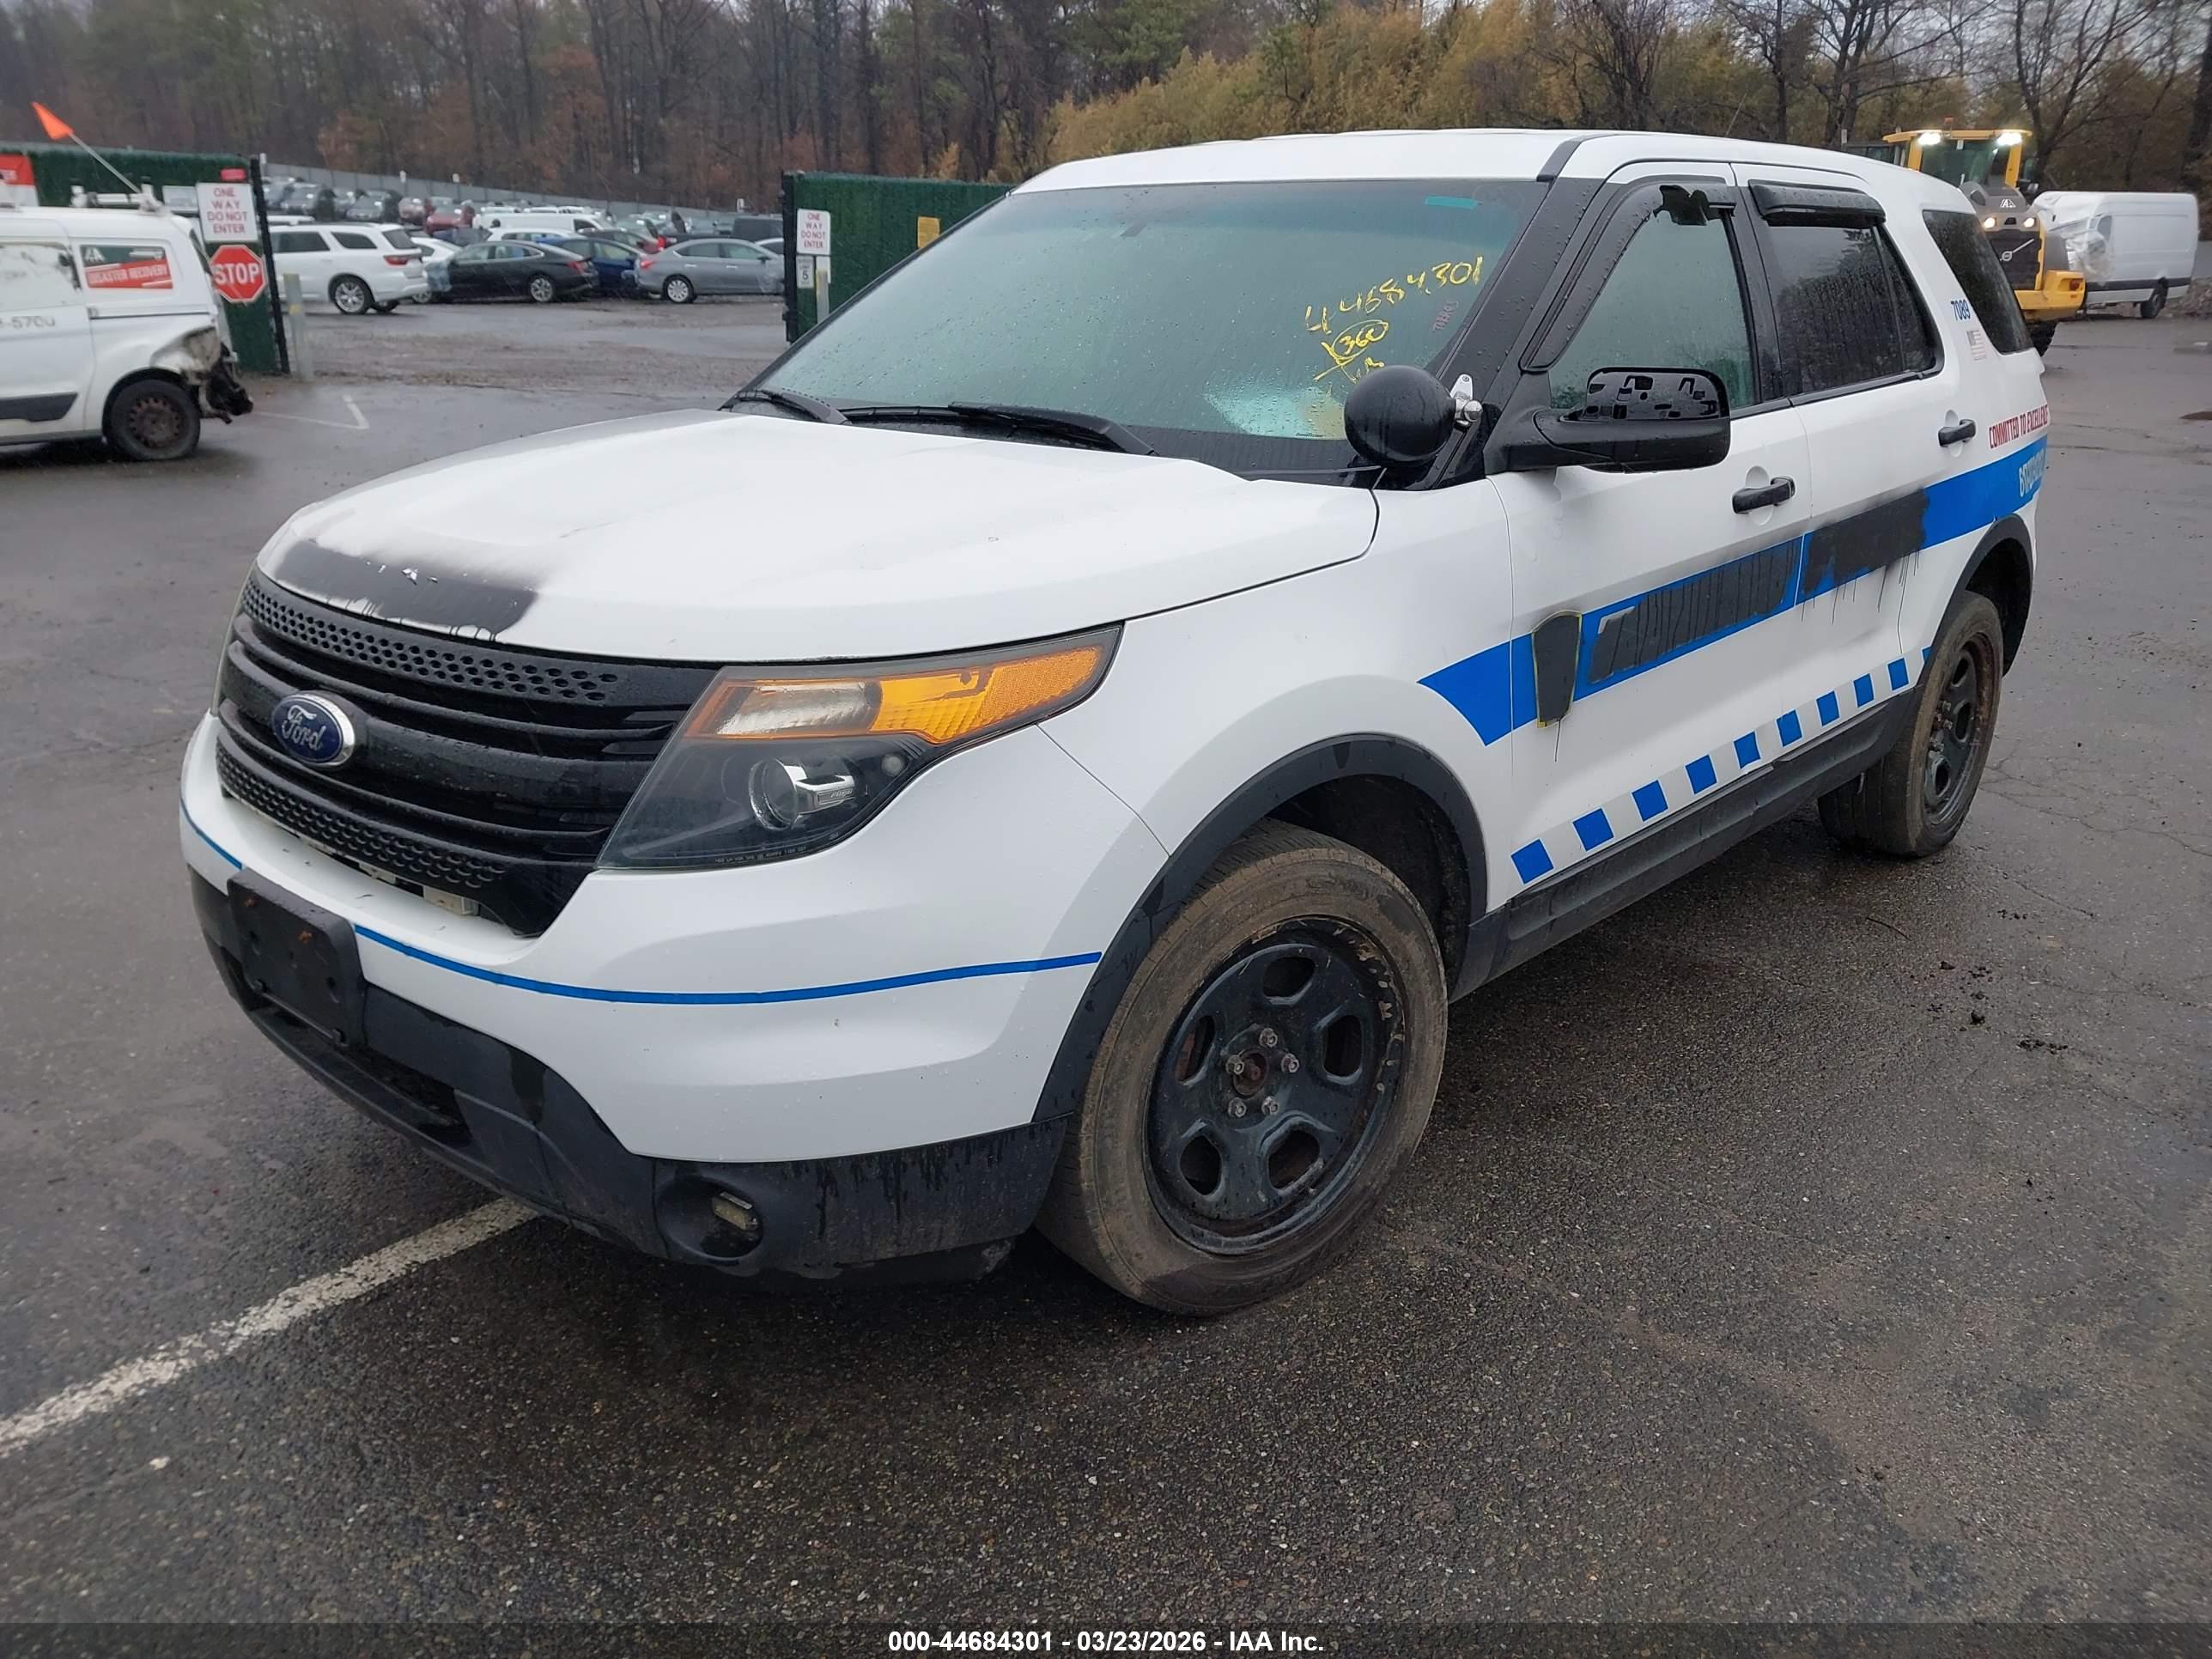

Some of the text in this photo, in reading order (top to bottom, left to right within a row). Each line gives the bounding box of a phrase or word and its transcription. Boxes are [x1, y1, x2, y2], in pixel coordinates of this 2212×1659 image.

[214, 187, 235, 197] ONE
[207, 211, 247, 221] DO NOT
[807, 212, 821, 221] ONE
[213, 223, 246, 234] ENTER
[800, 230, 825, 240] DO NOT
[804, 240, 823, 248] ENTER
[215, 262, 259, 286] STOP
[1950, 298, 1972, 321] 7089
[1989, 421, 2020, 449] COMMITTED
[2020, 413, 2027, 436] TO
[282, 704, 326, 751] Ford
